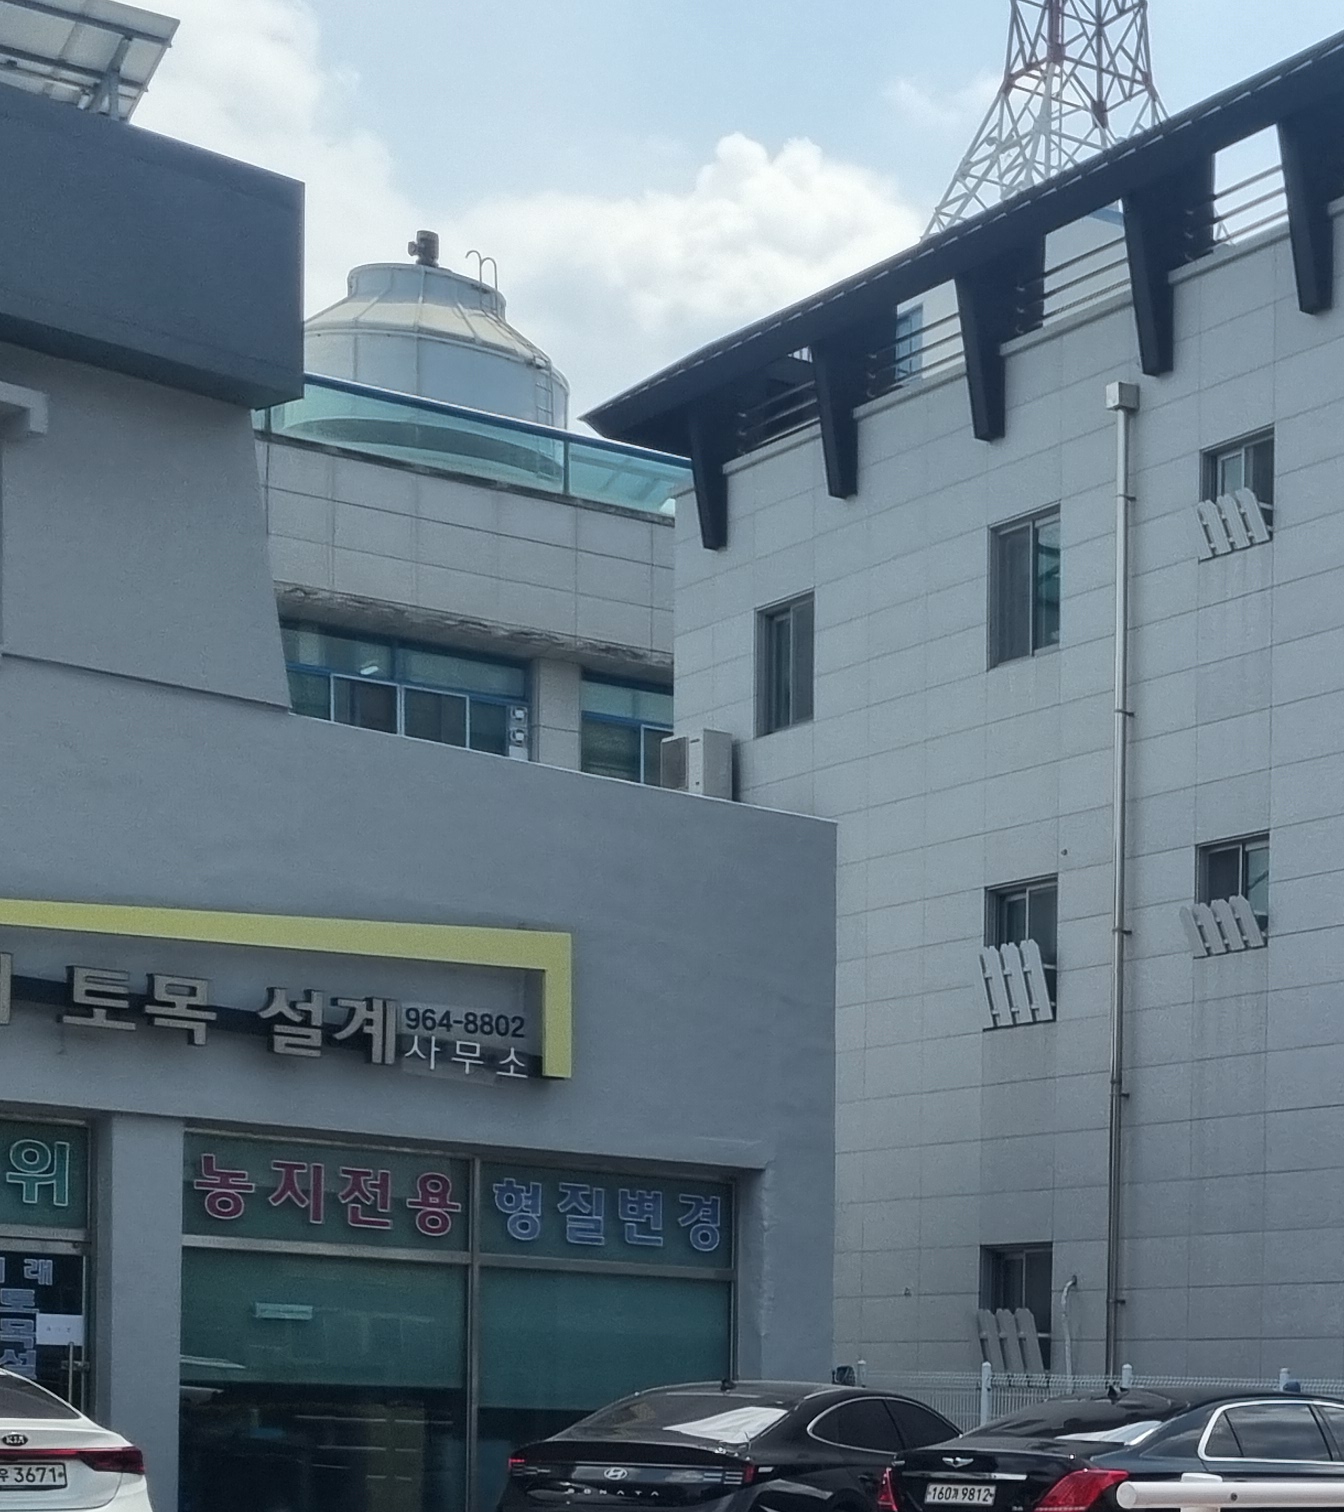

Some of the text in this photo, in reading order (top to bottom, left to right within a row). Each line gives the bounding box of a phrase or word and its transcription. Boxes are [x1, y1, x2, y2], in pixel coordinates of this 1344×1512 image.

[61, 966, 217, 1045] 토목
[258, 987, 397, 1065] 설계
[405, 1007, 525, 1038] 964-8802
[404, 1035, 528, 1078] 사무소
[6, 1139, 70, 1207] 위
[194, 1153, 461, 1236] 농지전용
[492, 1178, 721, 1251] 형질변경
[14, 1467, 57, 1482] 3671
[961, 1487, 991, 1502] 9812
